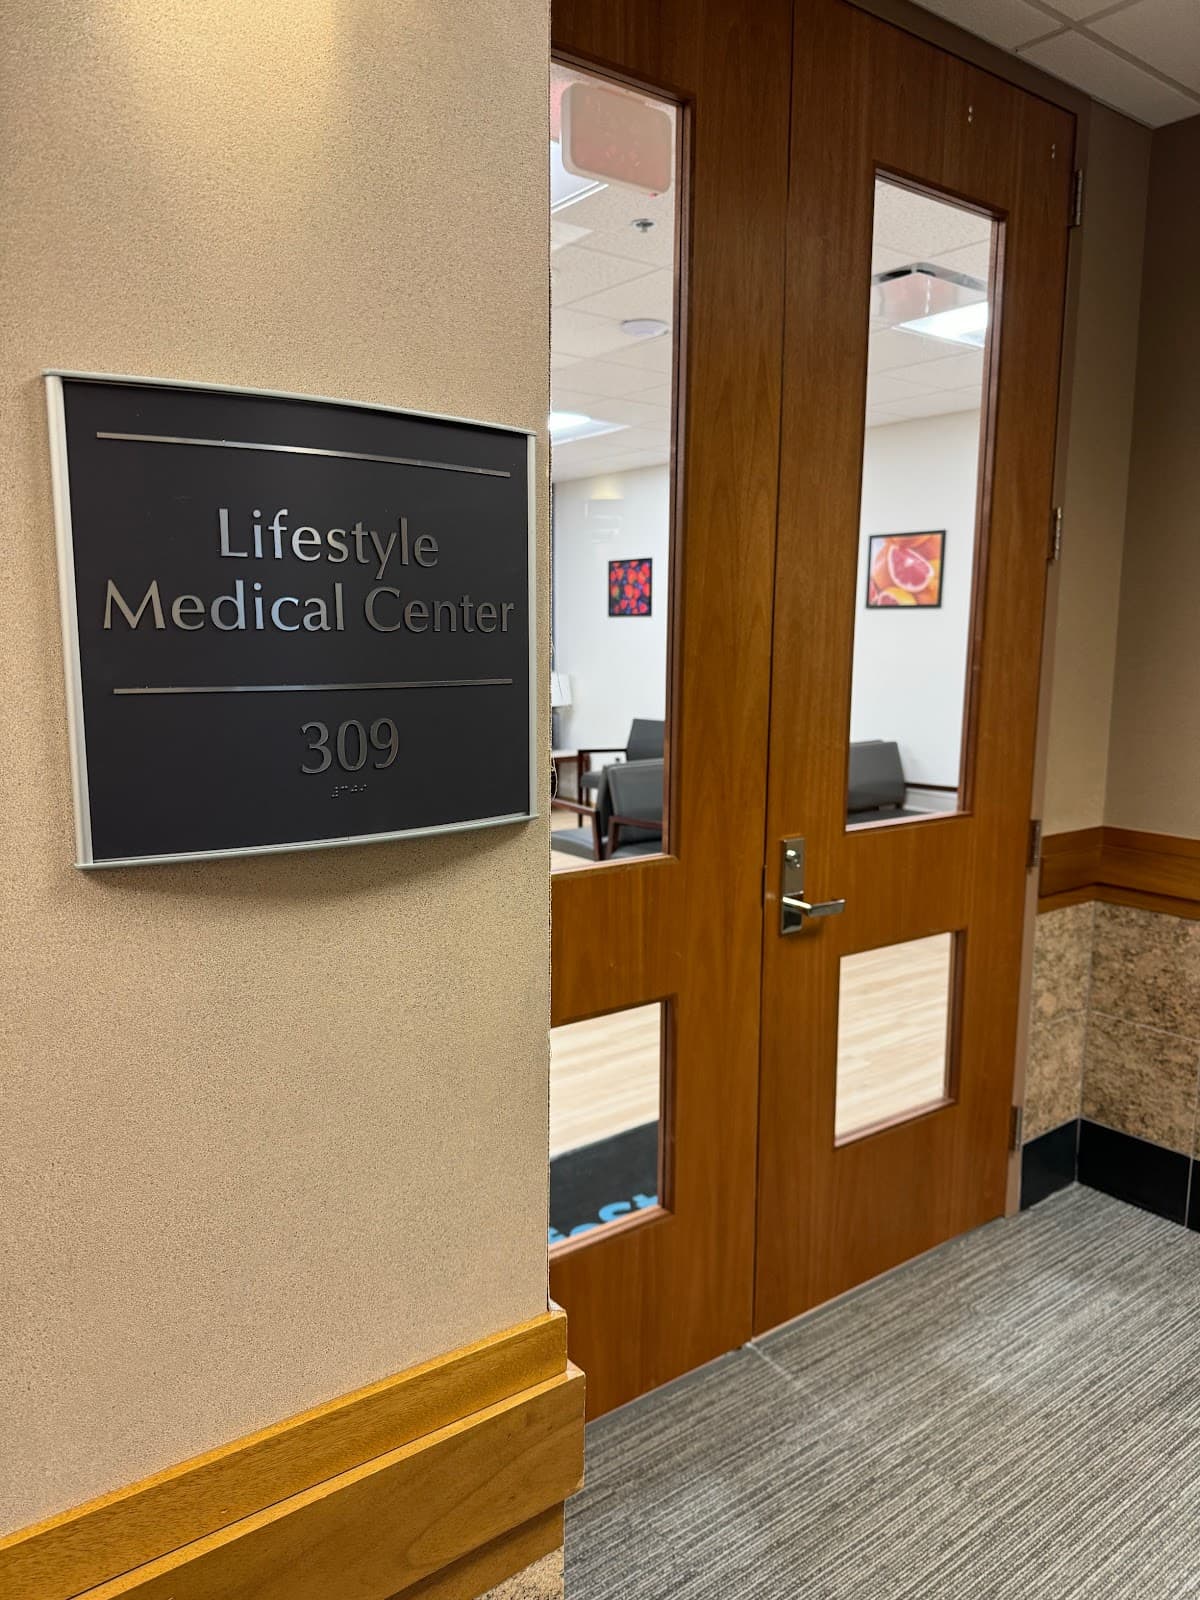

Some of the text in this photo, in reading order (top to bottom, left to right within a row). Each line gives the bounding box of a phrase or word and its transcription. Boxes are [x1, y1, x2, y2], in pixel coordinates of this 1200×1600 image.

[218, 507, 439, 580] Lifestyle
[103, 578, 515, 634] Medical Center
[300, 717, 400, 775] 309
